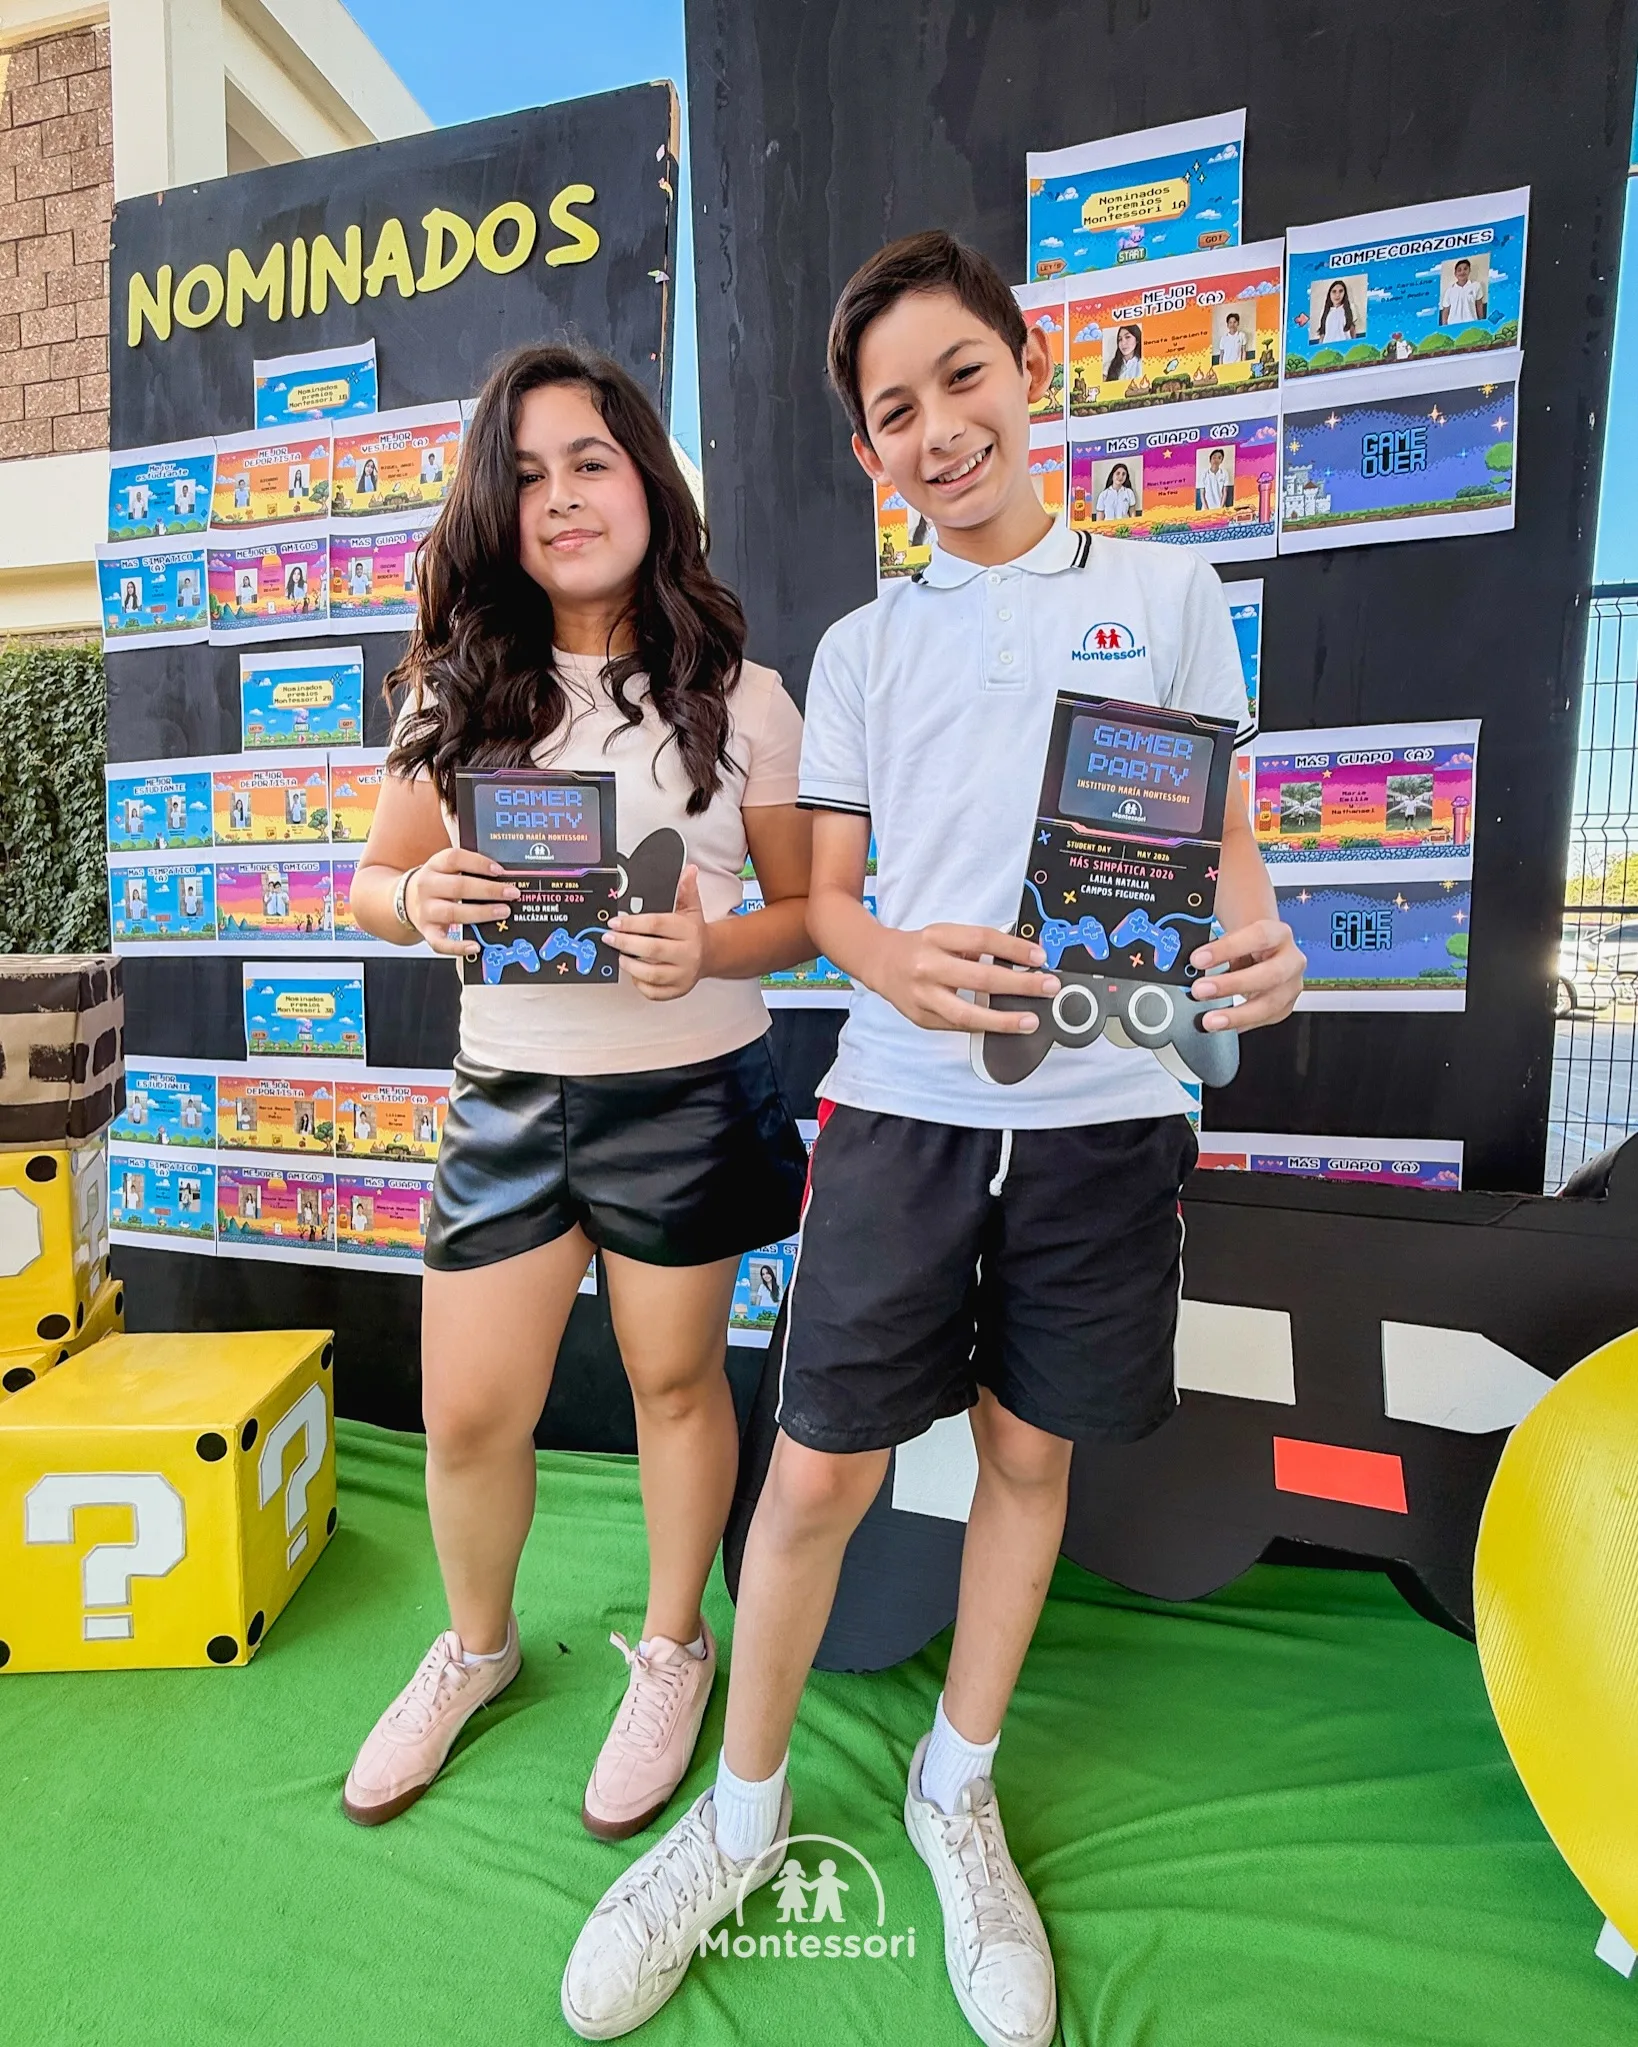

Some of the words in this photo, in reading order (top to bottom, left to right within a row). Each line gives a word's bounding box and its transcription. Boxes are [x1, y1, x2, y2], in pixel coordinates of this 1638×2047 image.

[1099, 187, 1170, 206] Nominados
[1107, 197, 1162, 214] premios
[1083, 206, 1162, 226] Montessori
[1171, 200, 1186, 210] 1A
[1118, 248, 1145, 262] START
[1330, 230, 1493, 268] ROMPECORAZONES
[127, 183, 601, 348] NOMINADOS
[1143, 285, 1195, 304] MEJOR
[1112, 300, 1185, 319] VESTIDO
[1198, 293, 1224, 305] (A)
[298, 384, 338, 396] Nominados
[301, 391, 334, 401] premios
[289, 396, 333, 408] Montessori
[379, 432, 411, 443] MEJOR
[1148, 430, 1199, 446] GUAPO
[1211, 425, 1238, 439] (A)
[1362, 426, 1428, 457] GAME
[361, 441, 405, 453] VESTIDO
[412, 438, 429, 447] (A)
[258, 447, 288, 458] MEJOR
[244, 453, 302, 468] DEPORTISTA
[1361, 449, 1427, 478] OVER
[148, 463, 175, 473] Mejor
[136, 469, 189, 481] estudiante
[376, 534, 406, 545] GUAPO
[236, 546, 276, 558] MEJORES
[281, 541, 318, 553] AMIGOS
[1071, 646, 1146, 661] Montessori
[282, 684, 323, 692] Nominados
[1093, 725, 1193, 760] GAMER
[1338, 751, 1393, 765] GUAPO
[1405, 749, 1434, 761] (A)
[253, 772, 283, 780] MEJOR
[1087, 752, 1189, 787] PARTY
[146, 778, 171, 787] MEJOR
[240, 779, 298, 788] DEPORTISTA
[358, 776, 383, 784] VEST
[134, 785, 184, 794] ESTUDIANTE
[1077, 779, 1116, 792] INSTITUTO
[1117, 785, 1141, 797] MARÍA
[1143, 789, 1190, 804] MONTESSORI
[494, 789, 583, 807] GAMER
[495, 811, 583, 829] PARTY
[1112, 811, 1146, 822] Montessori
[525, 832, 546, 840] MARÍA
[1066, 840, 1096, 852] STUDENT
[1097, 845, 1112, 854] DAY
[1137, 850, 1151, 859] MAY
[1153, 852, 1170, 861] 2026
[239, 864, 279, 872] MEJORES
[283, 863, 319, 871] AMIGOS
[1069, 855, 1090, 869] MÁS
[1093, 860, 1146, 876] SIMPÁTICA
[1149, 868, 1174, 880] 2026
[1089, 874, 1113, 885] LAILA
[1115, 877, 1150, 890] NATALIA
[518, 893, 562, 902] SIMPÁTICO
[564, 894, 585, 903] 2026
[1080, 884, 1113, 897] CAMPOS
[1115, 889, 1156, 902] FIGUEROA
[522, 904, 541, 912] POLO
[542, 903, 560, 912] RENÉ
[513, 913, 549, 922] BALCÁZAR
[550, 914, 569, 922] LUGO
[1331, 911, 1392, 931] GAME
[1331, 930, 1392, 951] OVER
[150, 1074, 176, 1083] MEJOR
[260, 1081, 289, 1089] MEJOR
[137, 1081, 189, 1091] ESTUDIANTE
[246, 1088, 304, 1097] DEPORTISTA
[379, 1087, 410, 1095] MEJOR
[362, 1094, 405, 1102] VESTIDO
[1328, 1159, 1382, 1172] GUAPO
[1392, 1161, 1420, 1174] (A)
[243, 1169, 283, 1178] MEJORES
[287, 1173, 324, 1182] AMIGOS
[389, 1180, 420, 1189] GUAPO
[24, 1472, 188, 1642] ?
